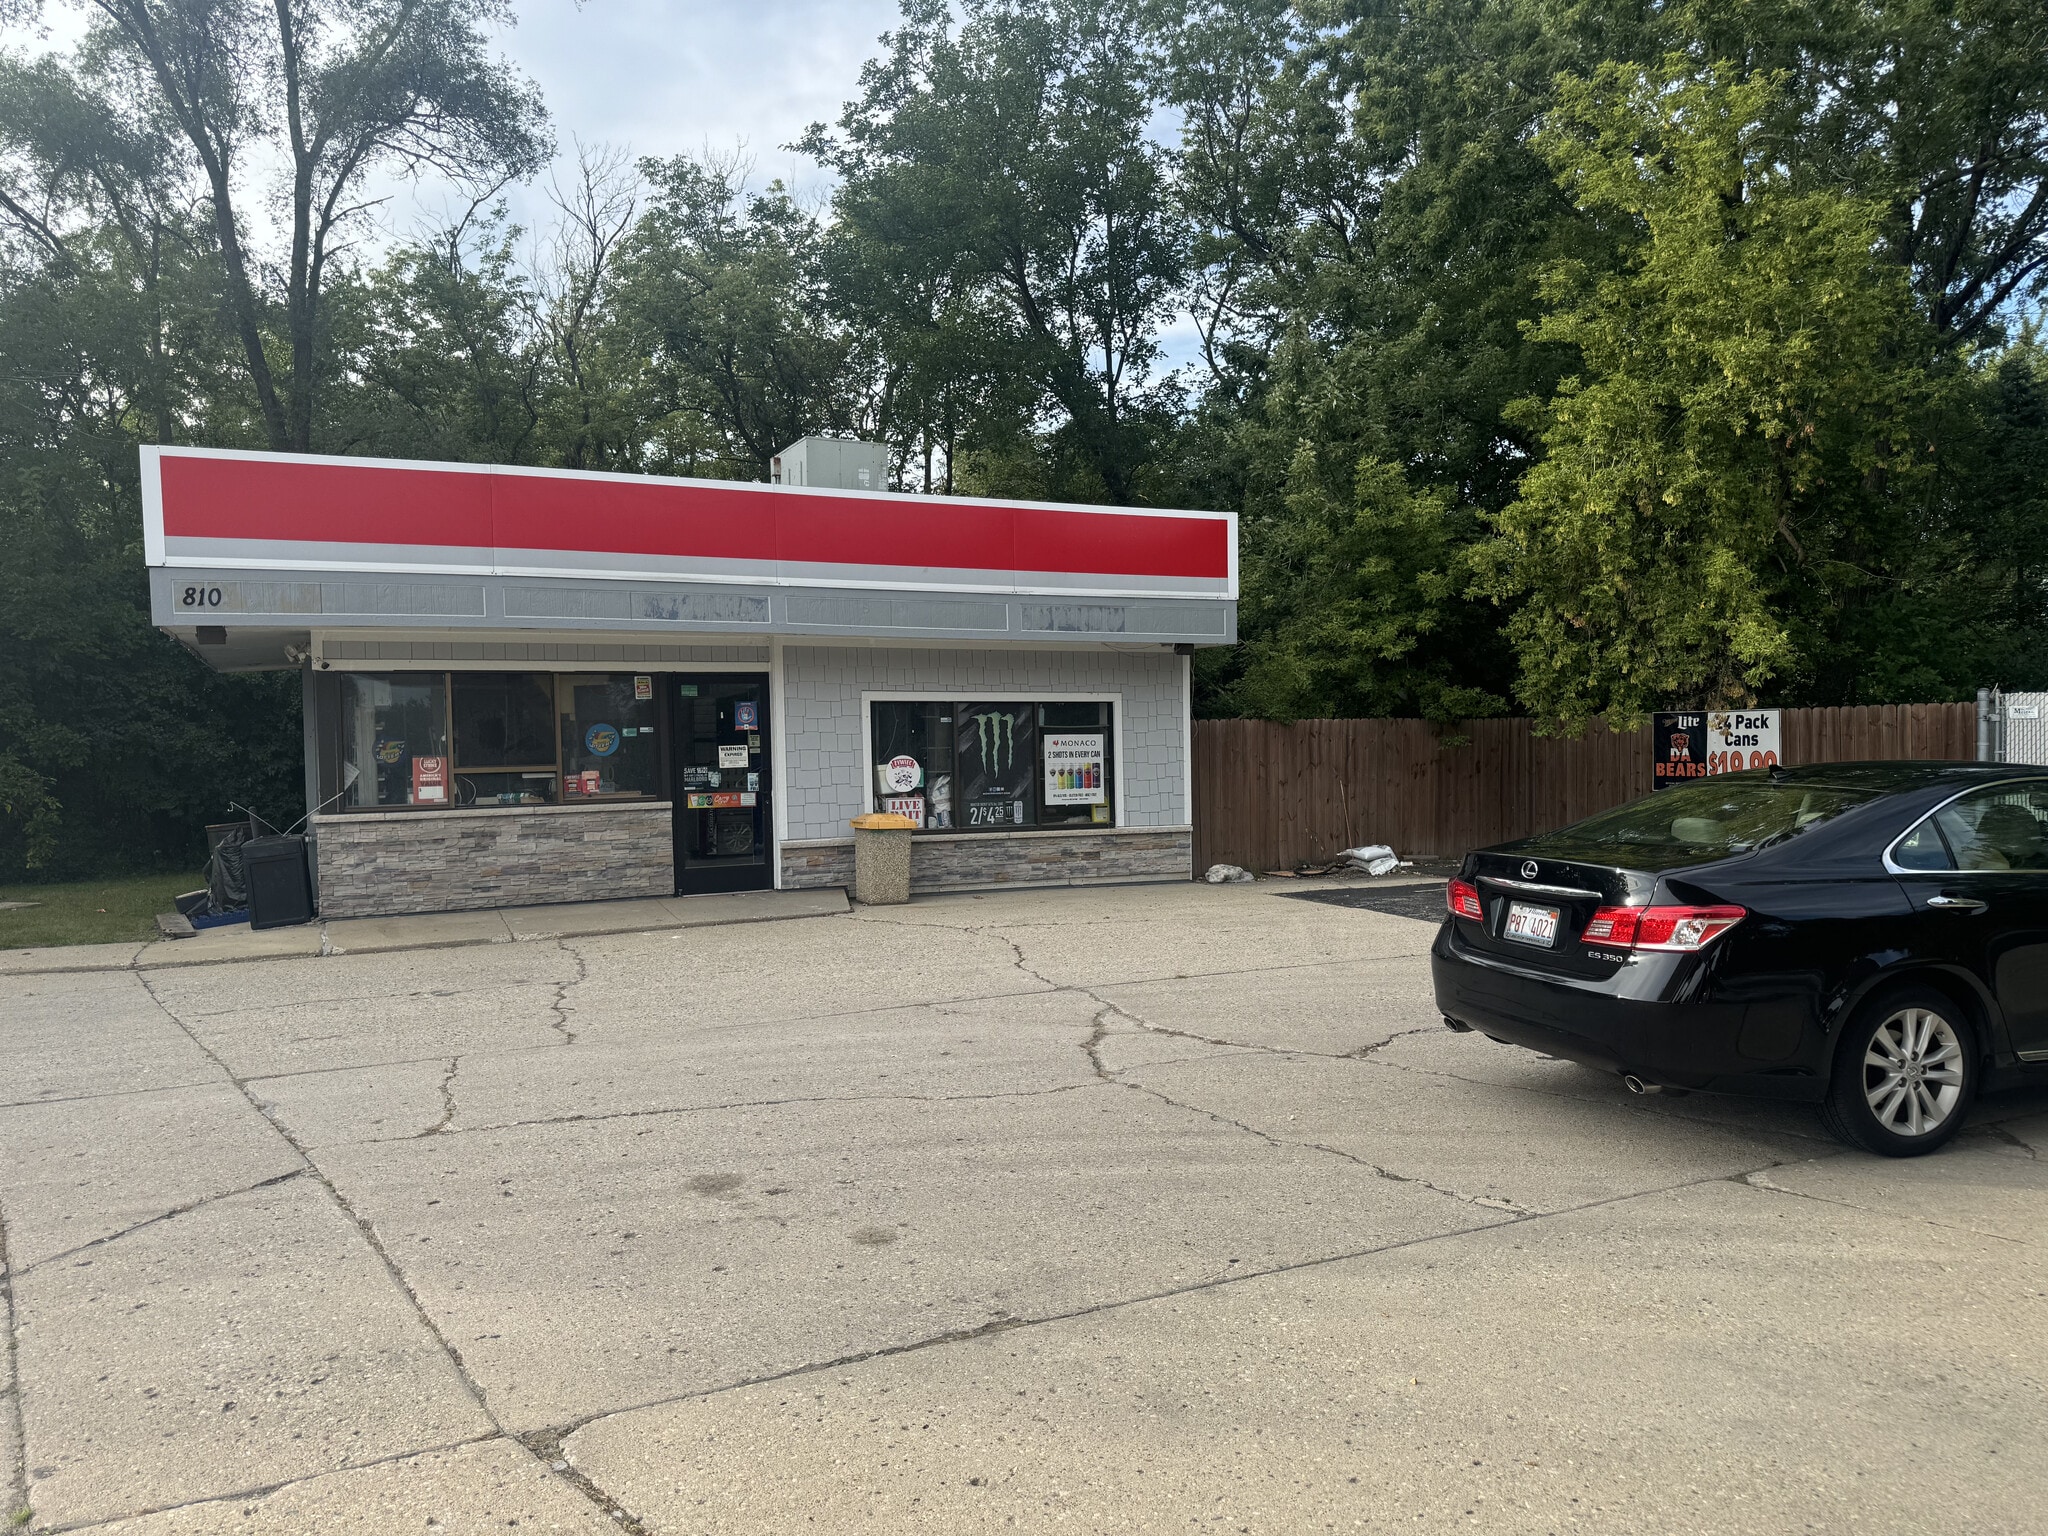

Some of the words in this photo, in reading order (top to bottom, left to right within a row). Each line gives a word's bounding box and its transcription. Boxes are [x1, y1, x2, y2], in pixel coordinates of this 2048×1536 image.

[182, 587, 222, 607] 810
[1677, 715, 1700, 730] Lite
[1735, 714, 1769, 729] Pack
[1724, 733, 1759, 747] Cans
[1048, 751, 1052, 759] 2
[1091, 750, 1101, 758] CAN
[1670, 747, 1691, 762] DA
[1656, 762, 1706, 777] BEARS
[891, 800, 920, 811] LIVE
[890, 810, 922, 820] AIT
[1510, 913, 1528, 934] P87
[1530, 917, 1554, 939] 4021
[1587, 951, 1601, 959] ES
[1602, 953, 1623, 963] 350
